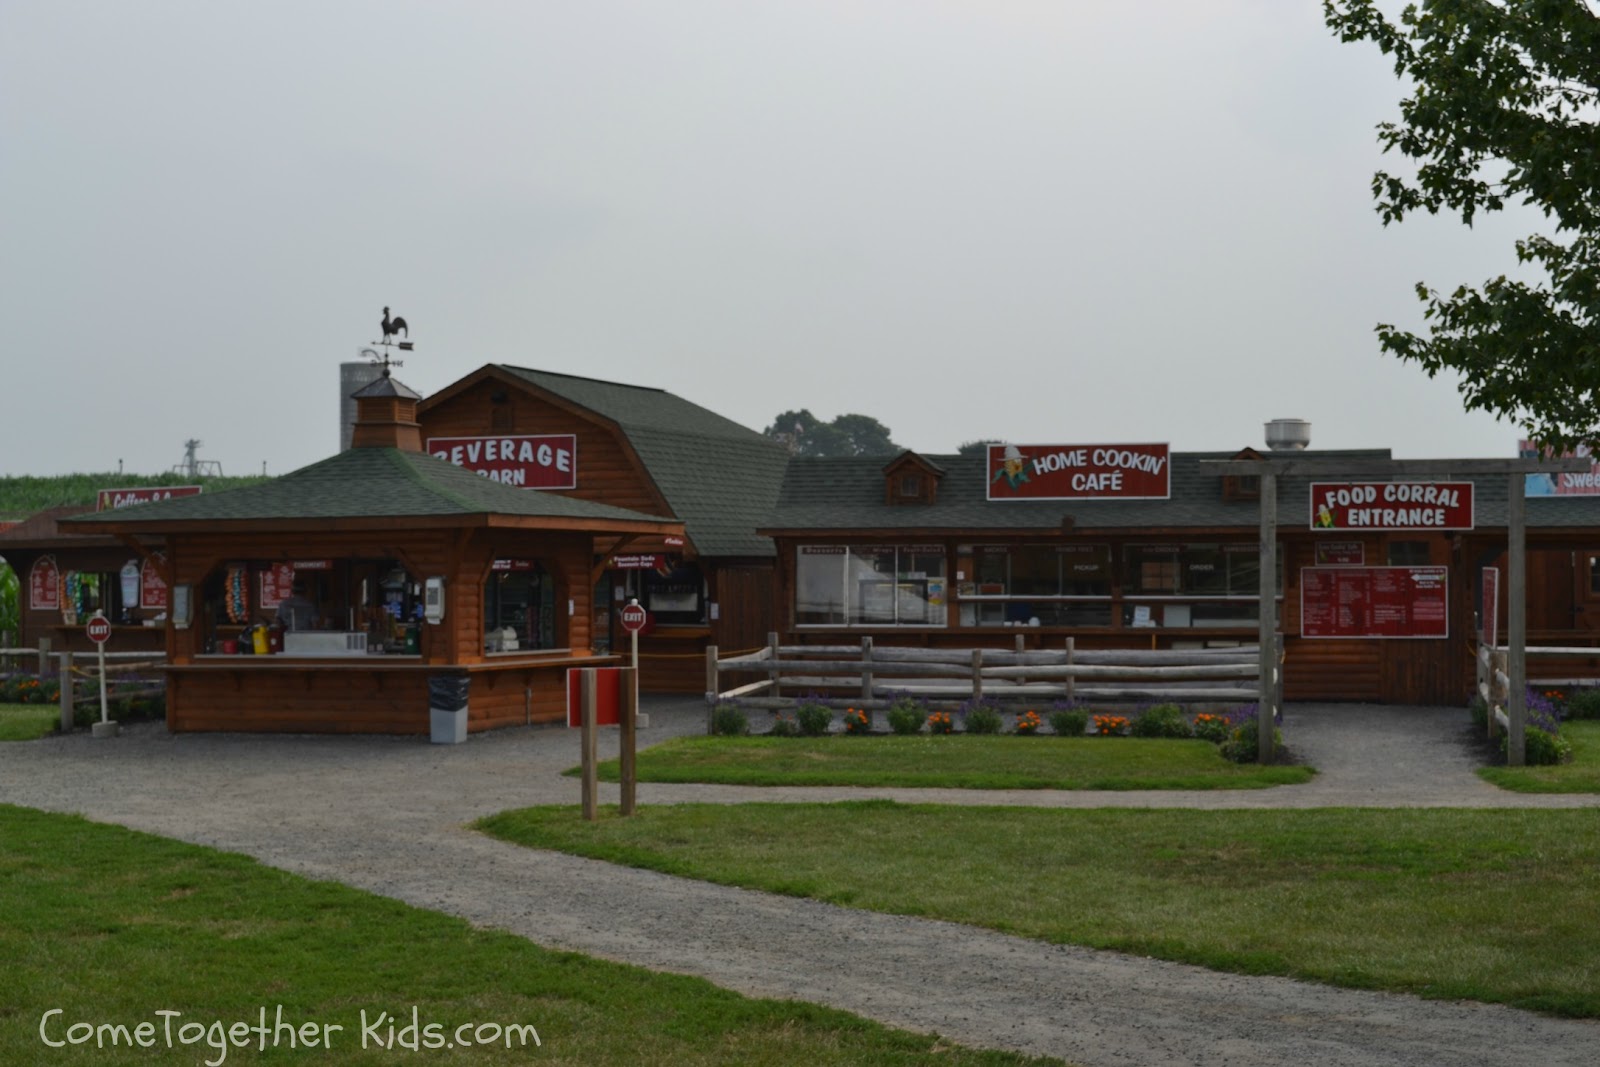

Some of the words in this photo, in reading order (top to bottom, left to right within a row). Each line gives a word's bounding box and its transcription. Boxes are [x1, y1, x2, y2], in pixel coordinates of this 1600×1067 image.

[1032, 449, 1088, 475] HOME
[1092, 449, 1166, 475] COOKIN'
[1071, 470, 1123, 490] CAFÉ
[1325, 486, 1377, 508] FOOD
[1383, 485, 1459, 507] CORRAL
[1347, 508, 1446, 526] ENTRANCE
[623, 612, 642, 622] EXIT
[90, 625, 107, 635] EXIT
